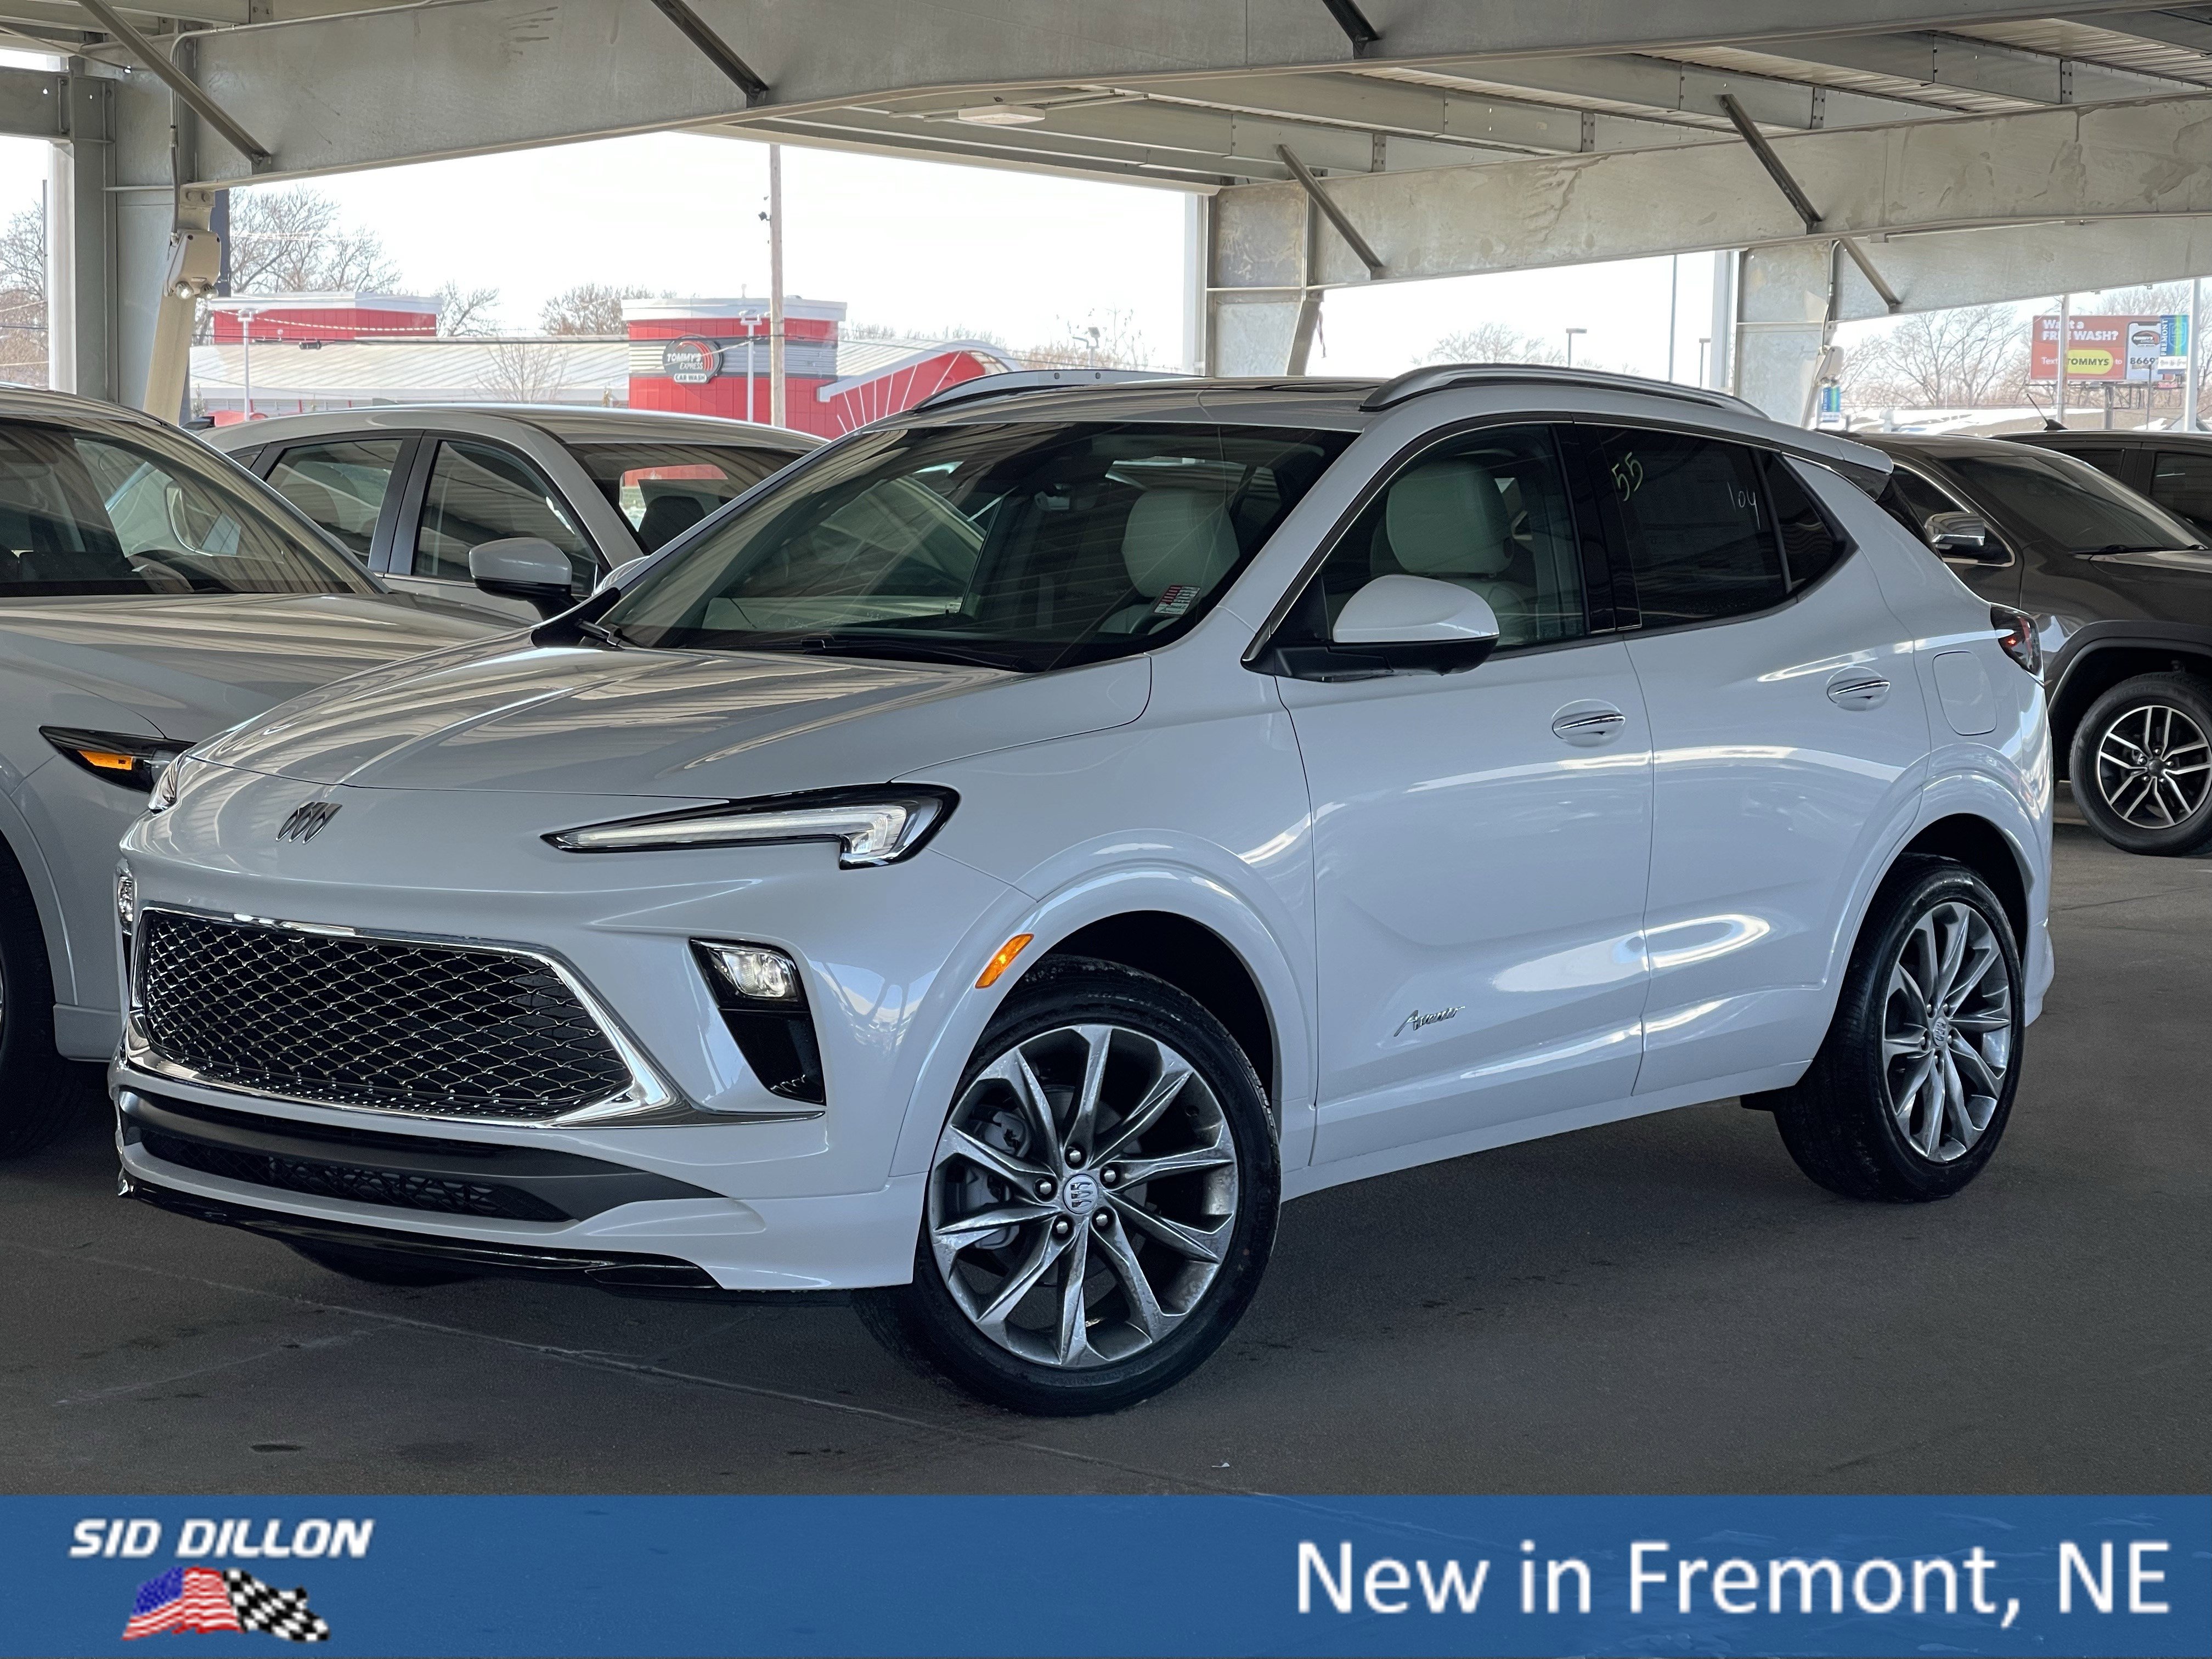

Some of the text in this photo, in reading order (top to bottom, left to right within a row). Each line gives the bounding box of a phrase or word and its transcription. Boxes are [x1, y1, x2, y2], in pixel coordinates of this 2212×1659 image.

[2042, 330, 2119, 341] FR WASH?
[2043, 319, 2084, 329] Wat a
[2160, 319, 2168, 356] FREMONT
[2041, 357, 2058, 365] Text
[2067, 357, 2109, 366] TOMMYS
[1611, 452, 1644, 502] 55
[1726, 481, 1760, 531] 104
